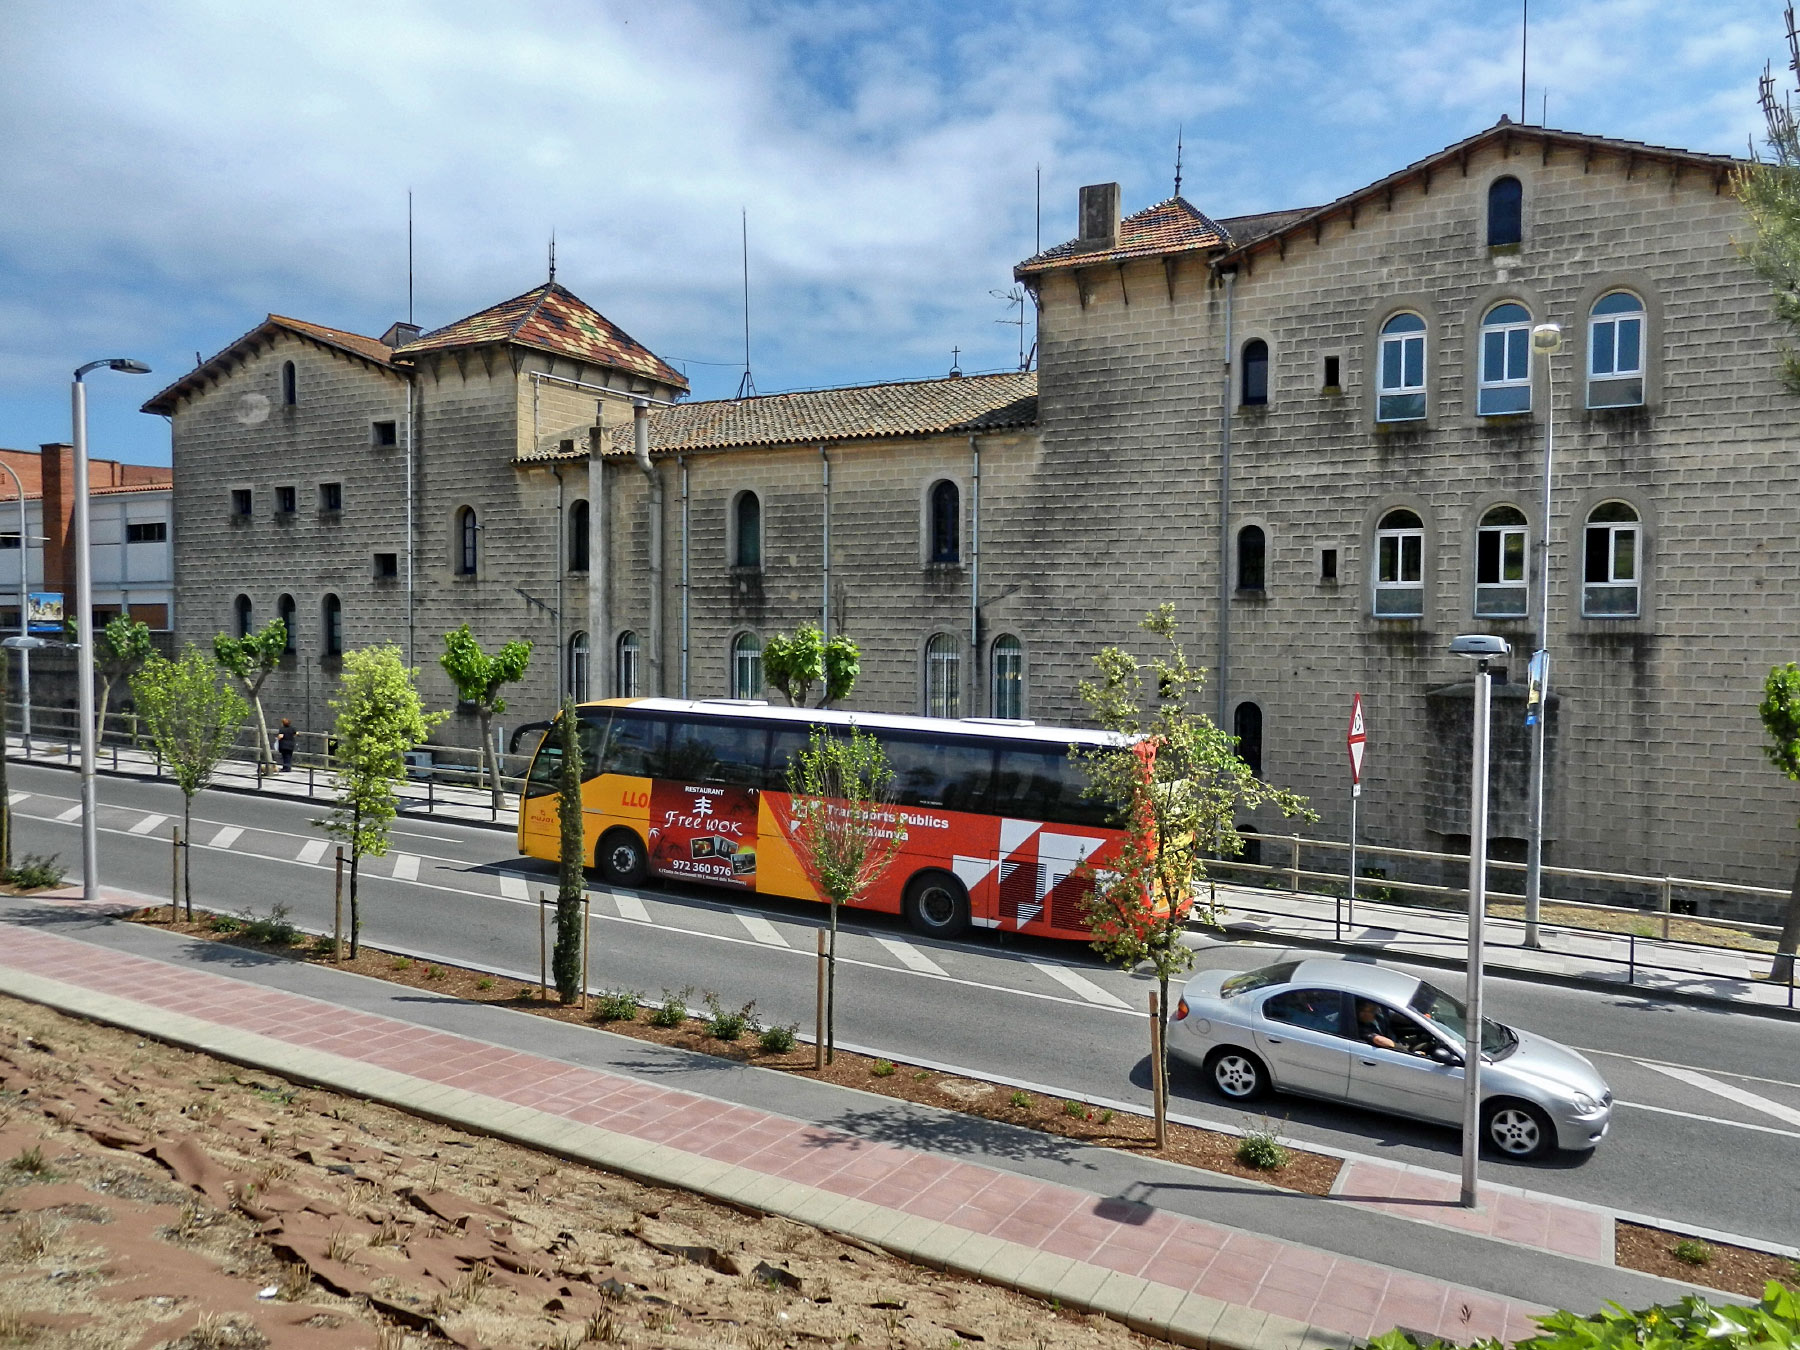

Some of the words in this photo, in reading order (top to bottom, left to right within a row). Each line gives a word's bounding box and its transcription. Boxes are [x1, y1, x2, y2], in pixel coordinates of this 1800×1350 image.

[621, 791, 651, 809] LLO
[684, 786, 725, 796] RESTAURANT
[664, 810, 702, 829] Free
[900, 812, 949, 829] Públics
[672, 859, 691, 871] 972
[692, 862, 711, 874] 360
[713, 865, 732, 877] 976
